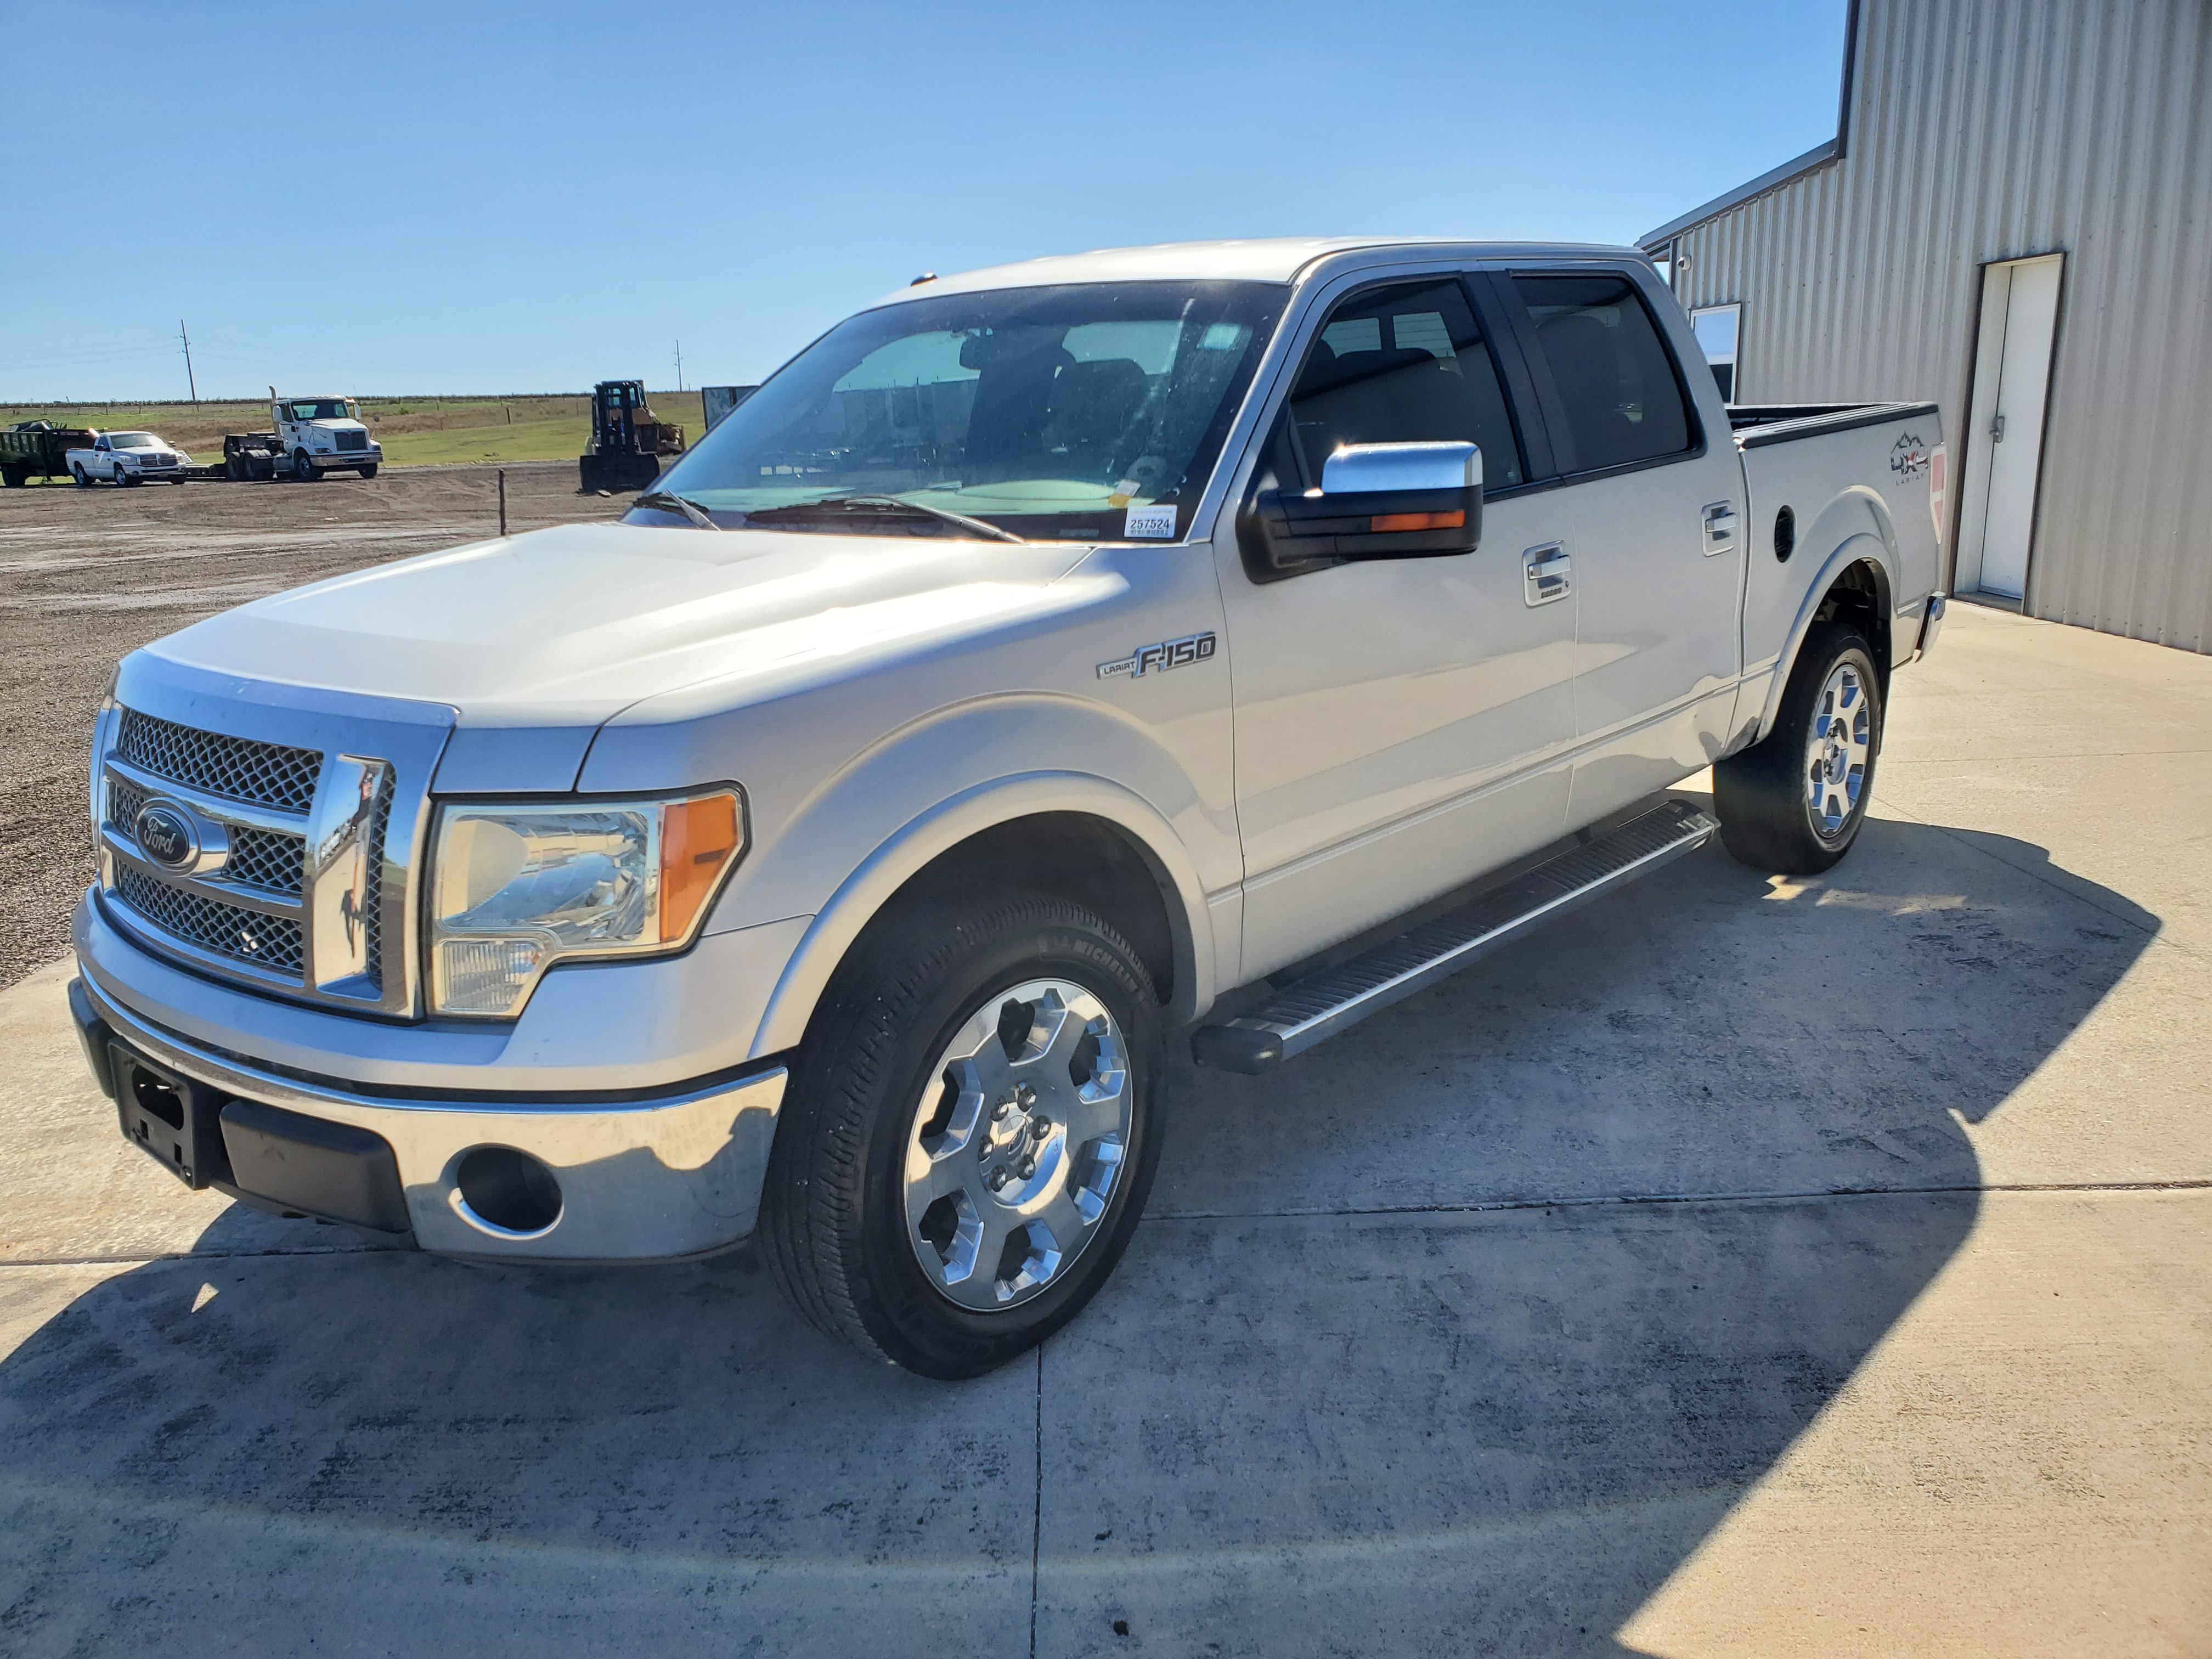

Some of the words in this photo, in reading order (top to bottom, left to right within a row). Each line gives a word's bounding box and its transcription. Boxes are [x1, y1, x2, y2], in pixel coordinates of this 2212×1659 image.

[1895, 473, 1925, 486] LARIAT
[1130, 518, 1170, 530] 257524
[1103, 661, 1136, 675] LARIAT
[144, 816, 176, 855] Ford
